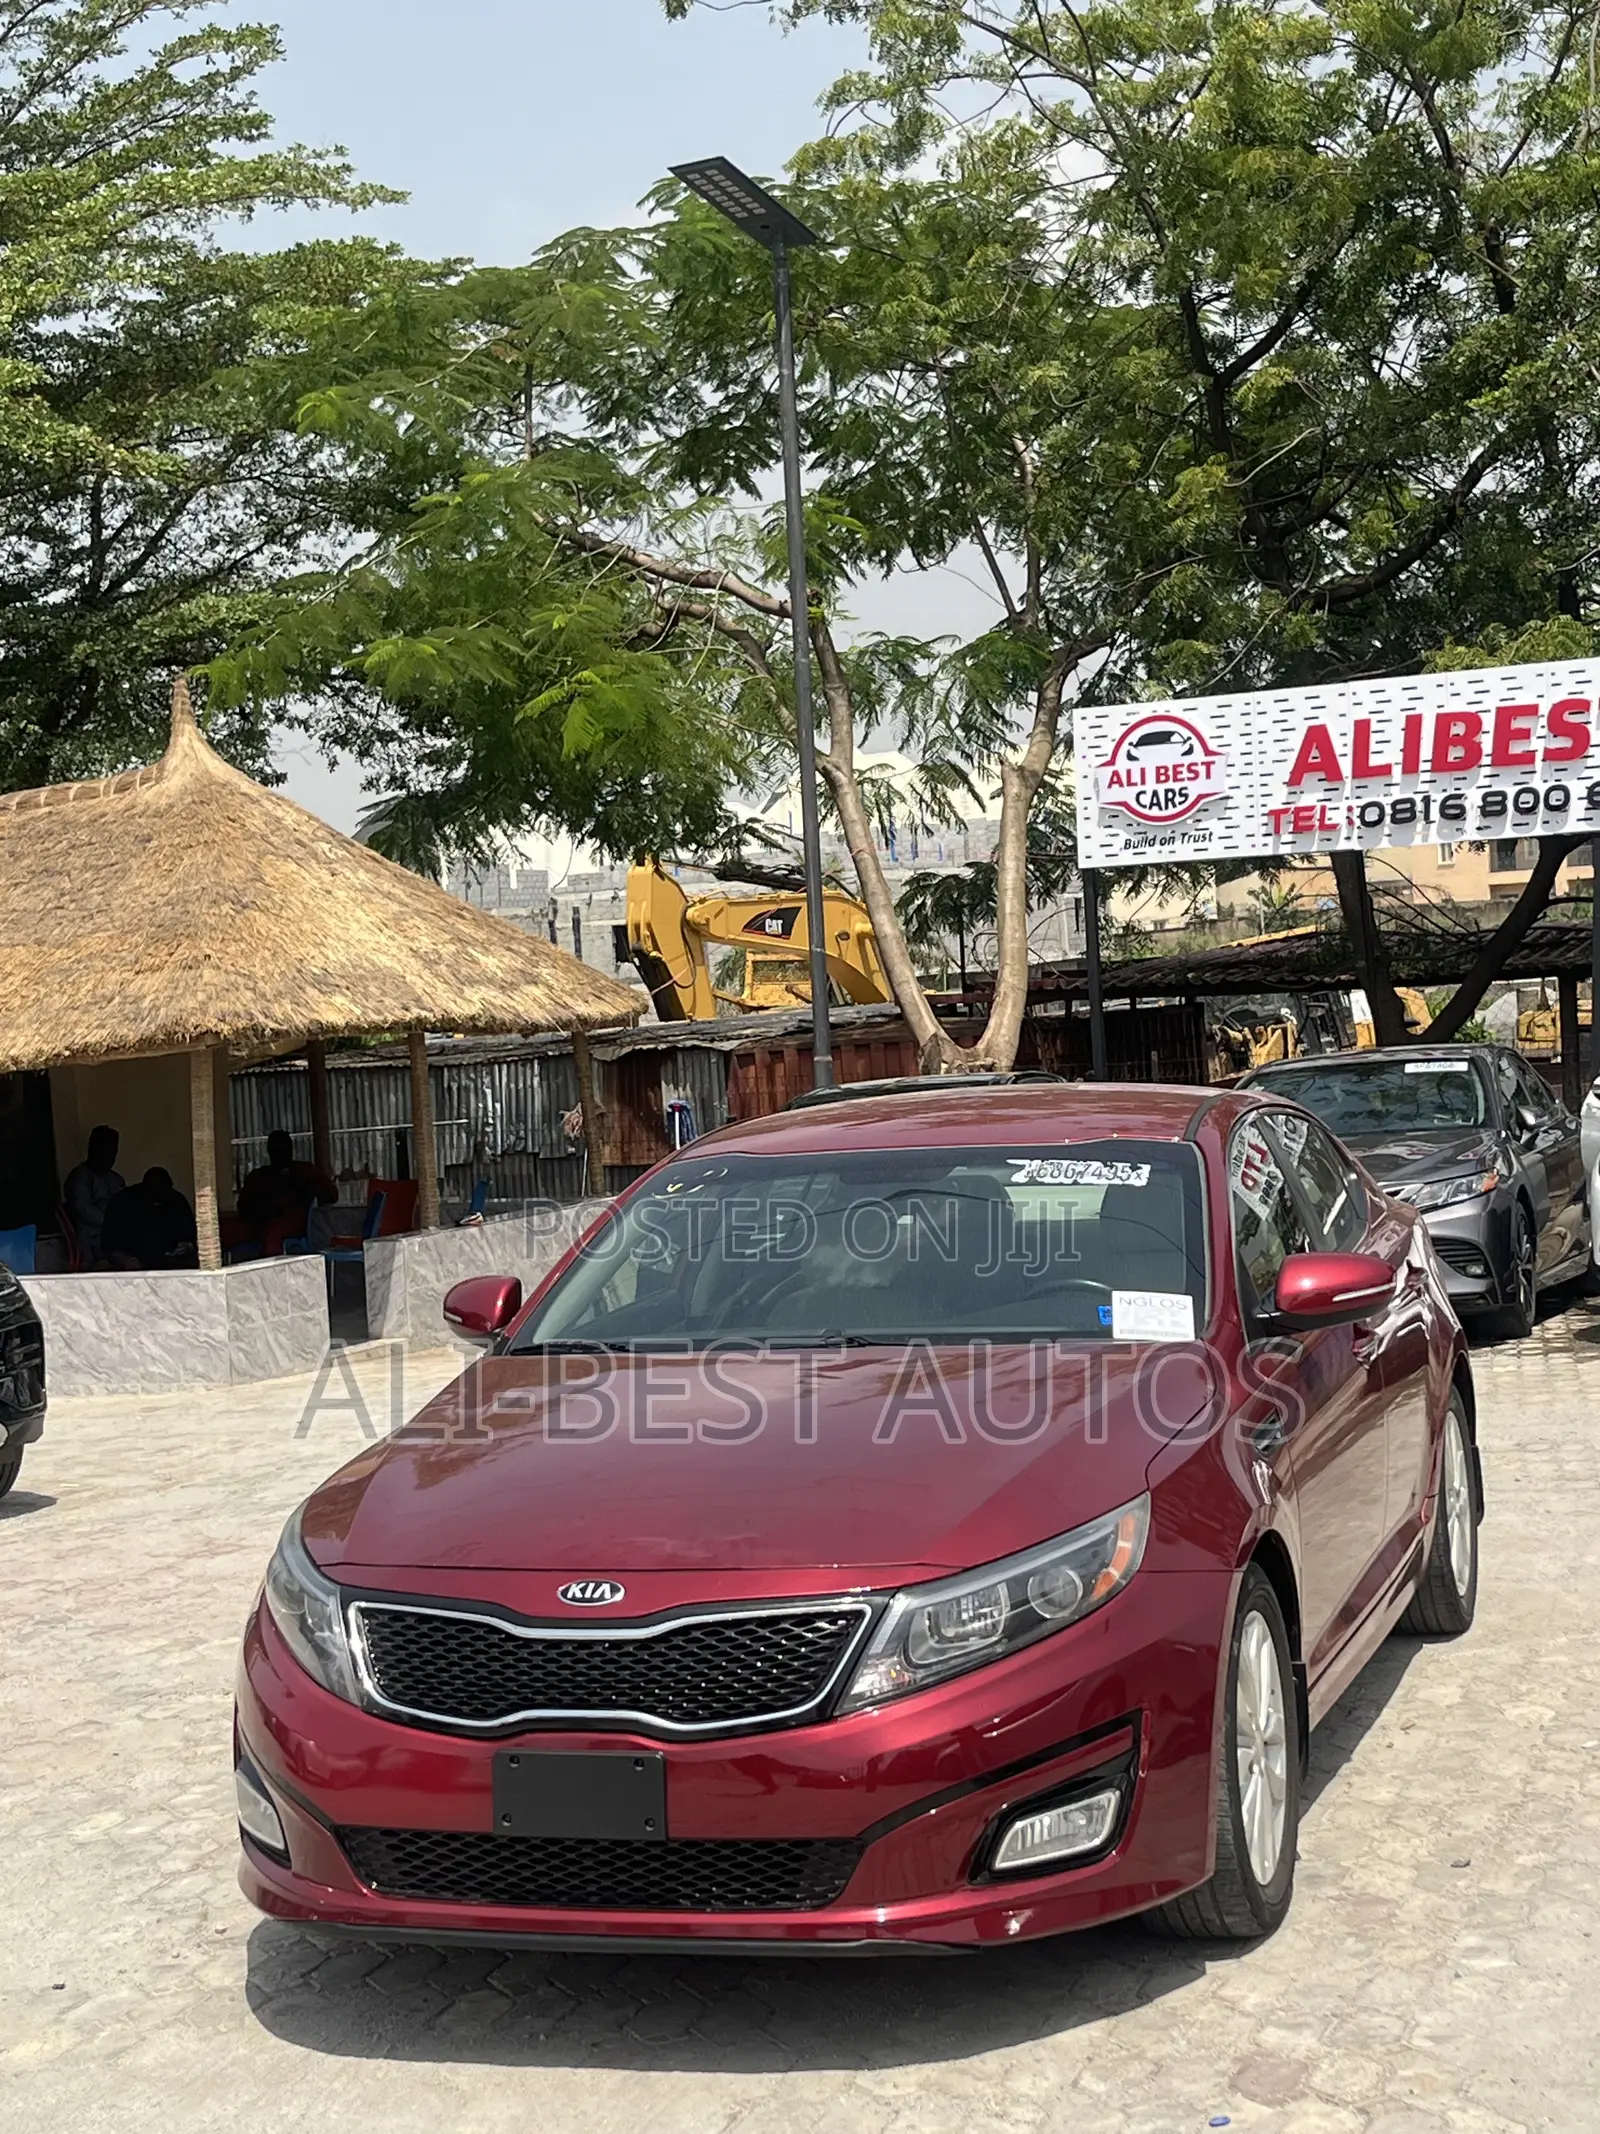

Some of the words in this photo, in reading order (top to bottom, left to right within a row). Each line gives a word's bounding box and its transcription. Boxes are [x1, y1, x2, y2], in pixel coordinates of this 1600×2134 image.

[1287, 698, 1600, 786] ALIBES
[1107, 767, 1146, 789] ALI
[1155, 760, 1216, 784] BEST
[1135, 786, 1190, 811] CARS
[1481, 784, 1571, 818] 800
[1123, 835, 1157, 850] Build
[1159, 836, 1176, 846] on
[1180, 831, 1214, 844] Trust
[765, 918, 783, 935] CAT
[566, 1582, 612, 1600] KIA
